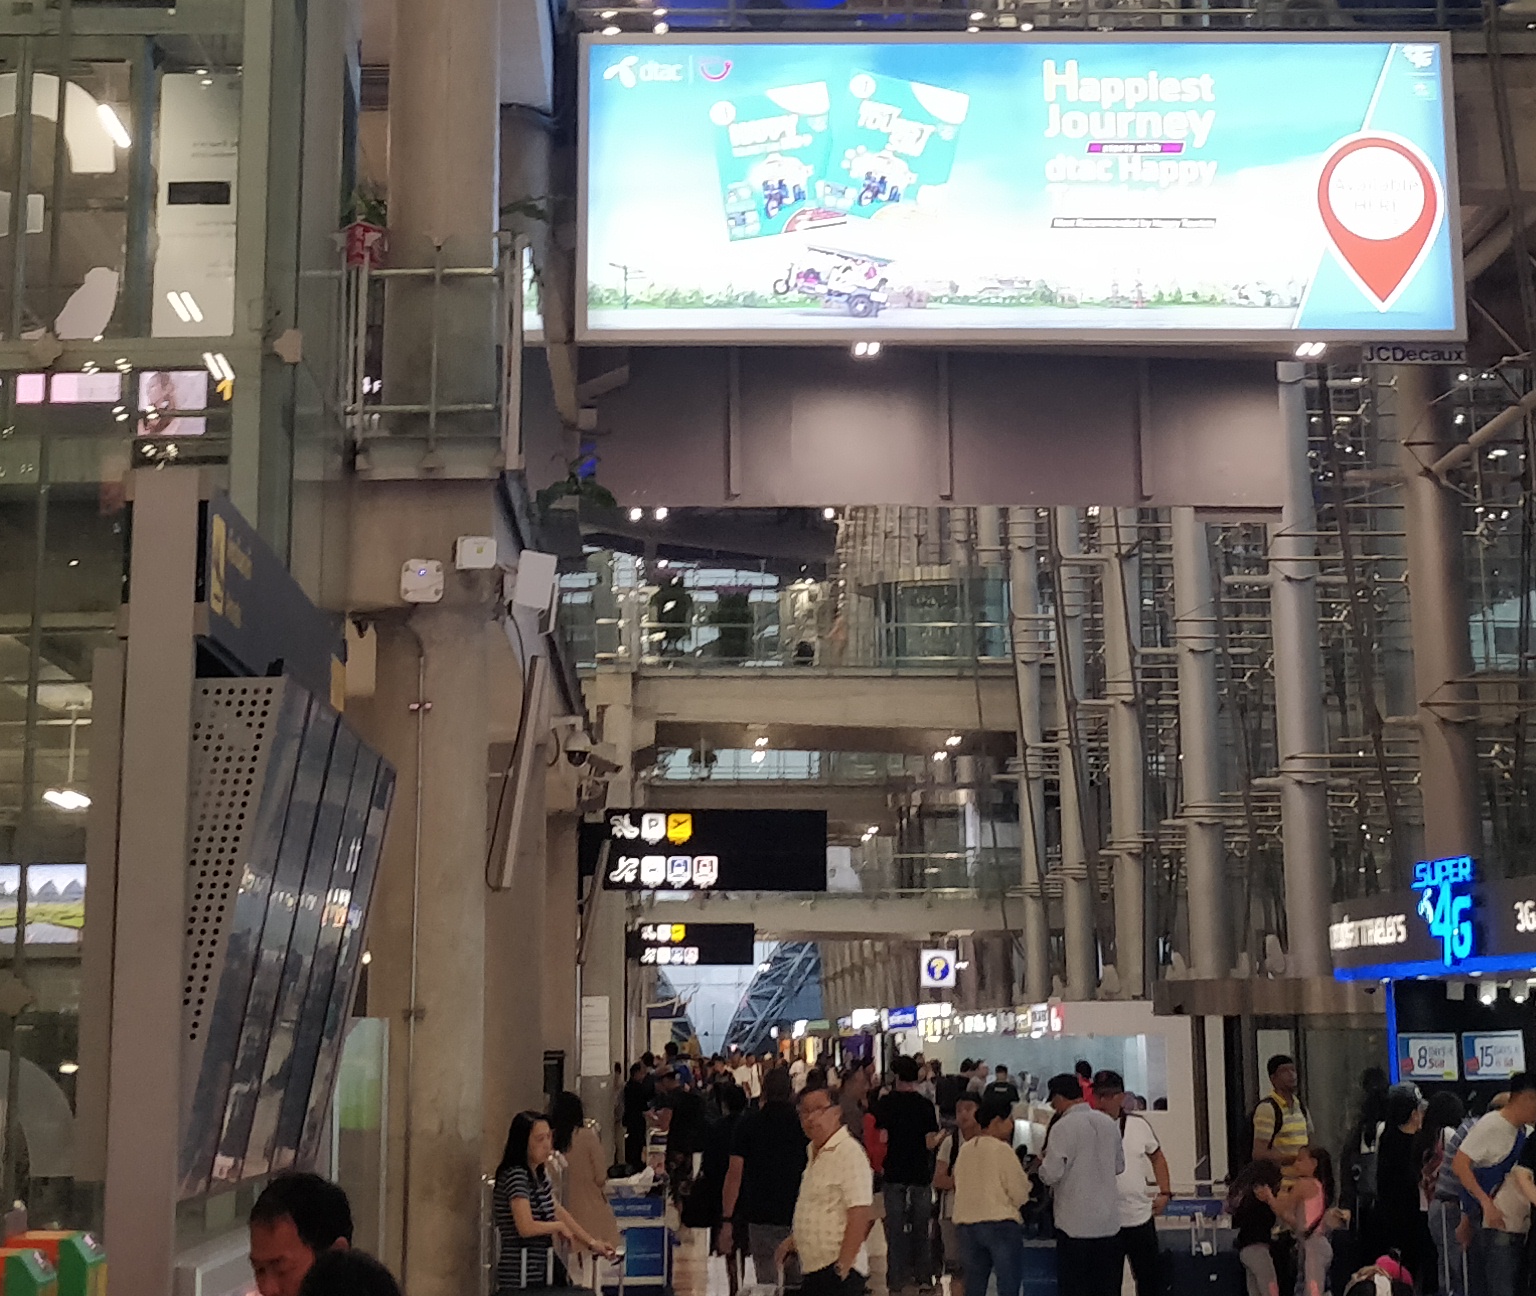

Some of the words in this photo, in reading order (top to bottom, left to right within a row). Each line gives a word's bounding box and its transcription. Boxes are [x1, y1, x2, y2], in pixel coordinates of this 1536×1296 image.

[639, 60, 684, 82] dtac
[1042, 59, 1216, 109] Happiest
[1044, 103, 1216, 148] Journey
[1045, 153, 1114, 182] dtac
[1119, 154, 1218, 191] Happy
[1365, 346, 1464, 362] JCDecaux
[1413, 857, 1473, 890] SUPER
[1431, 882, 1473, 967] 4G
[1417, 1045, 1429, 1069] 8
[1479, 1045, 1494, 1068] 15
